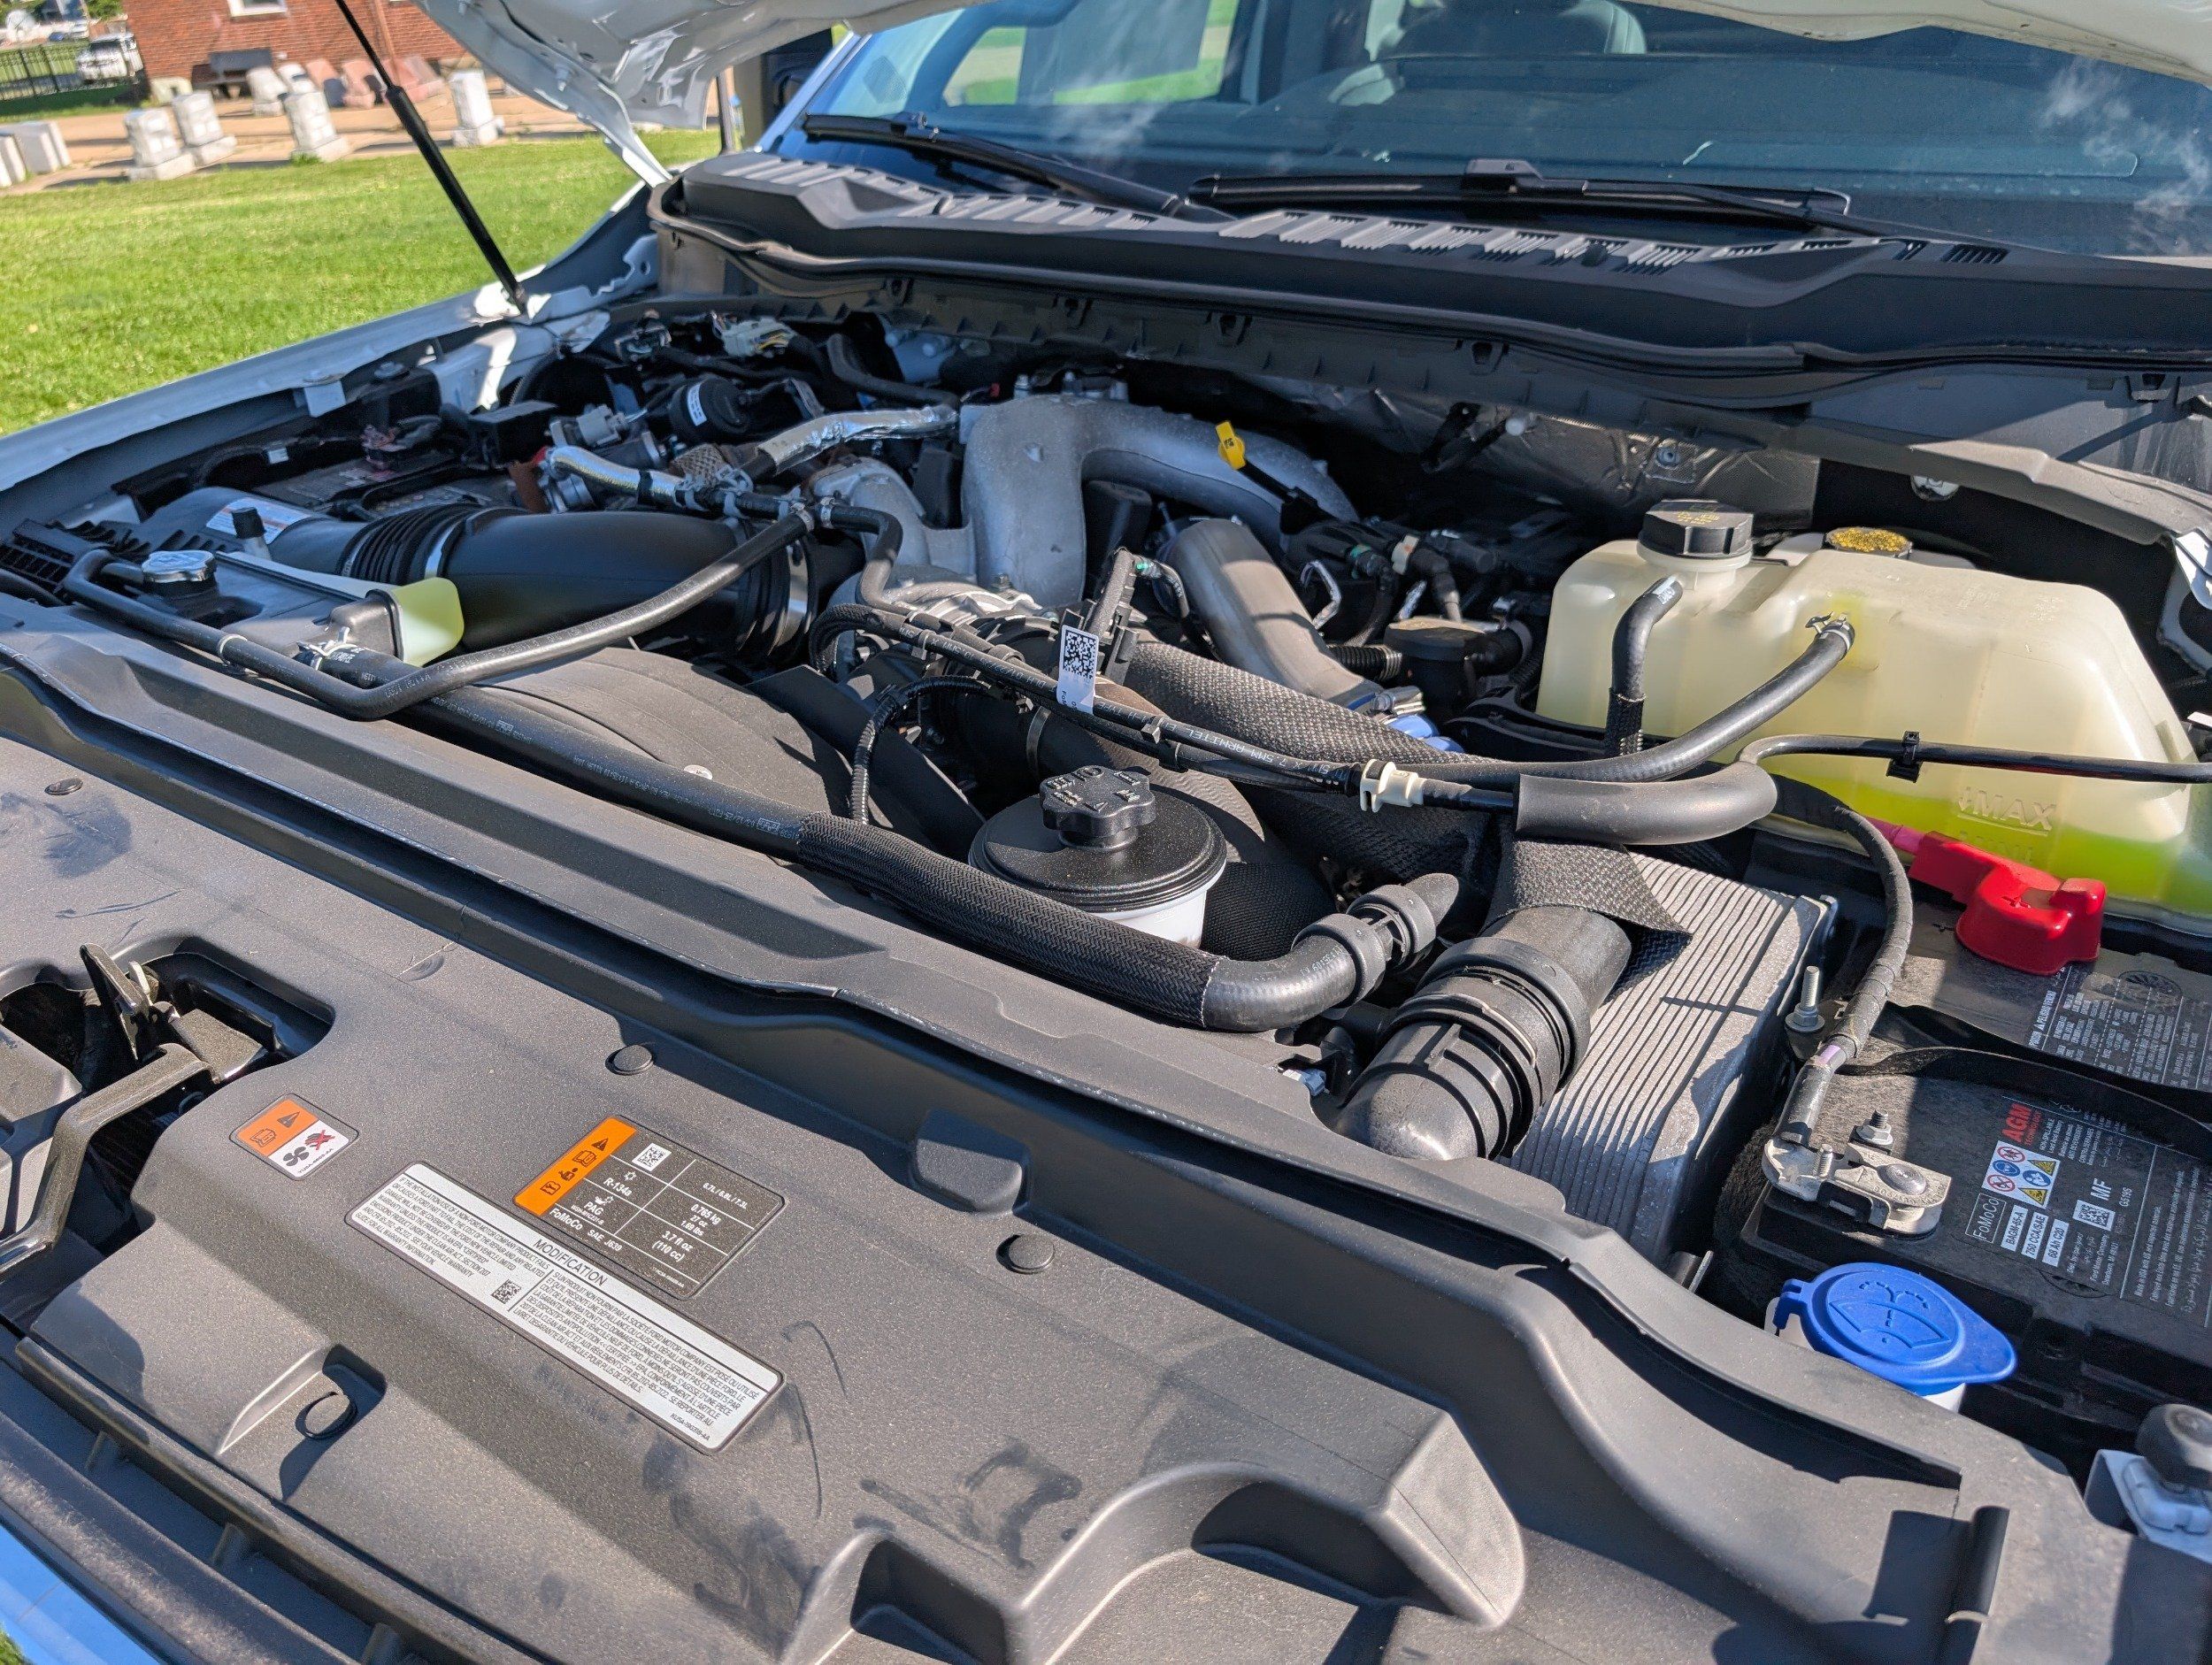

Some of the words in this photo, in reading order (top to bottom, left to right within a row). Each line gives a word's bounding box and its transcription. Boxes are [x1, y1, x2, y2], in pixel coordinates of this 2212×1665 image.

[1187, 728, 1246, 754] ARNITEL
[1972, 789, 2056, 832] MAX
[2001, 1101, 2031, 1142] AGM
[602, 1177, 634, 1196] R-134a
[2090, 1178, 2111, 1201] MF
[582, 1201, 605, 1216] PAG
[689, 1203, 713, 1218] 0.765
[707, 1213, 723, 1225] kg
[733, 1198, 750, 1209] 7.3L
[679, 1219, 695, 1231] 1.69
[692, 1226, 706, 1236] lbs
[688, 1214, 701, 1223] 27
[1972, 1196, 2000, 1239] FoMoCo
[2005, 1210, 2024, 1245] BAGM-65-A
[547, 1207, 586, 1231] FoMoCo
[585, 1229, 605, 1241] SAE
[603, 1238, 623, 1252] J639
[2028, 1214, 2046, 1244] CCA/SAE
[2052, 1226, 2065, 1239] C20
[650, 1239, 672, 1255] (110
[666, 1248, 686, 1262] cc)
[660, 1230, 678, 1242] 3.7
[672, 1236, 685, 1246] fl
[680, 1241, 694, 1252] oz
[2024, 1243, 2037, 1255] 750
[2048, 1239, 2061, 1249] Ah
[533, 1239, 608, 1286] MODIFICATION
[2047, 1249, 2058, 1258] 68
